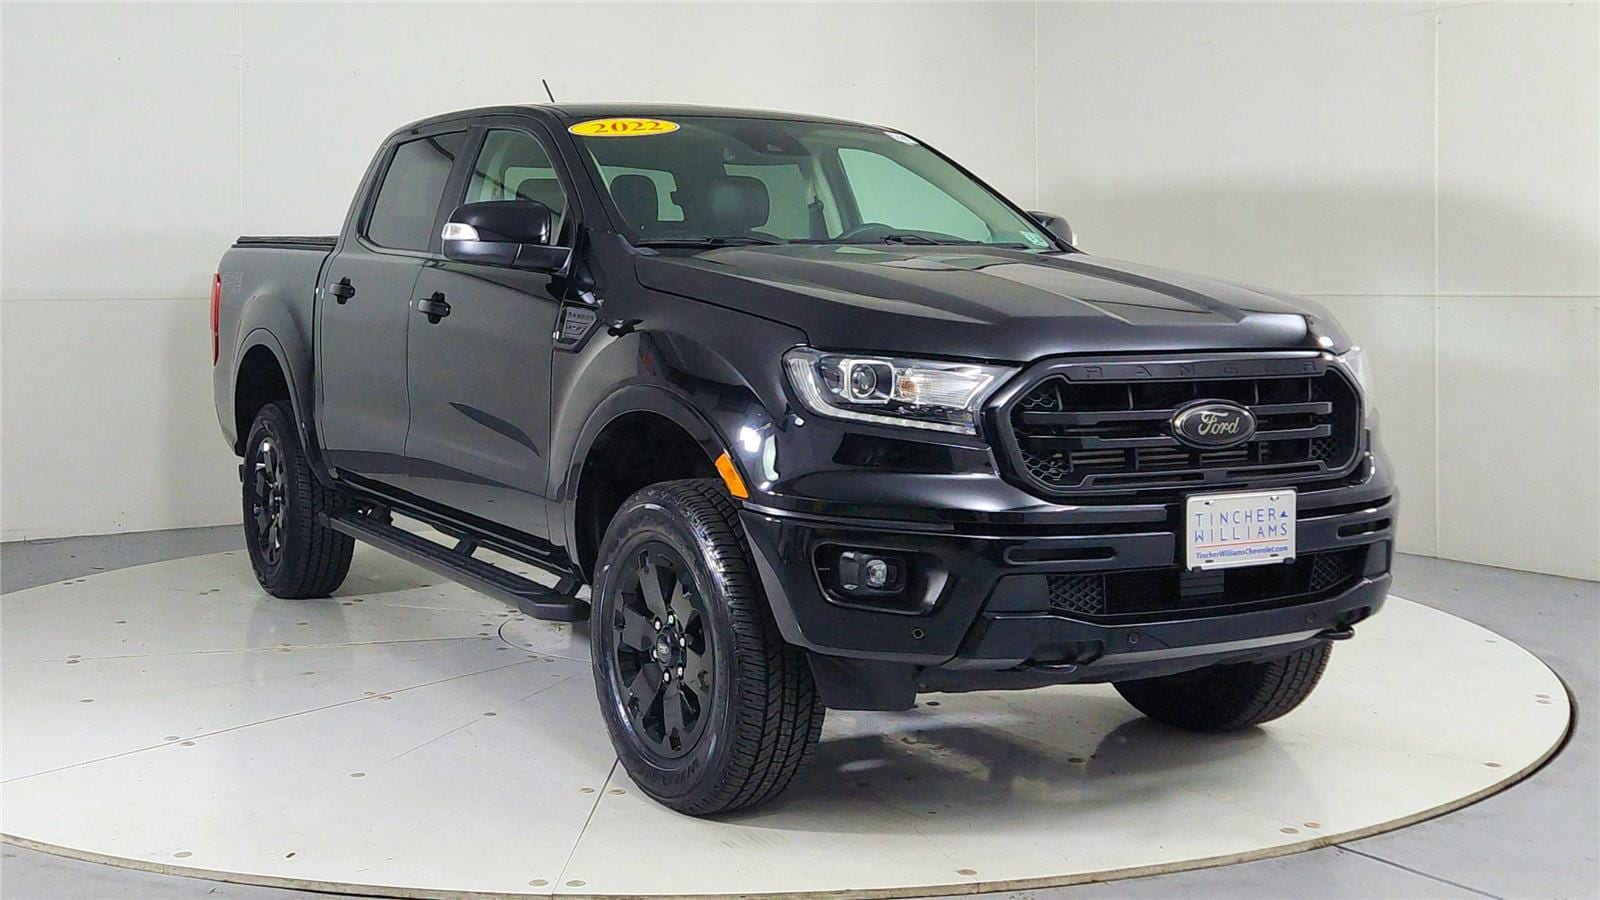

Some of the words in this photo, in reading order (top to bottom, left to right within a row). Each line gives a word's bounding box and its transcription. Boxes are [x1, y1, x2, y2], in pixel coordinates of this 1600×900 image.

[591, 121, 664, 134] 2022
[1198, 411, 1240, 436] Ford
[1194, 507, 1278, 528] TINCHER
[1194, 522, 1288, 543] WILLIAMS
[1195, 545, 1289, 560] TincherWilliamsChevrolet.com
